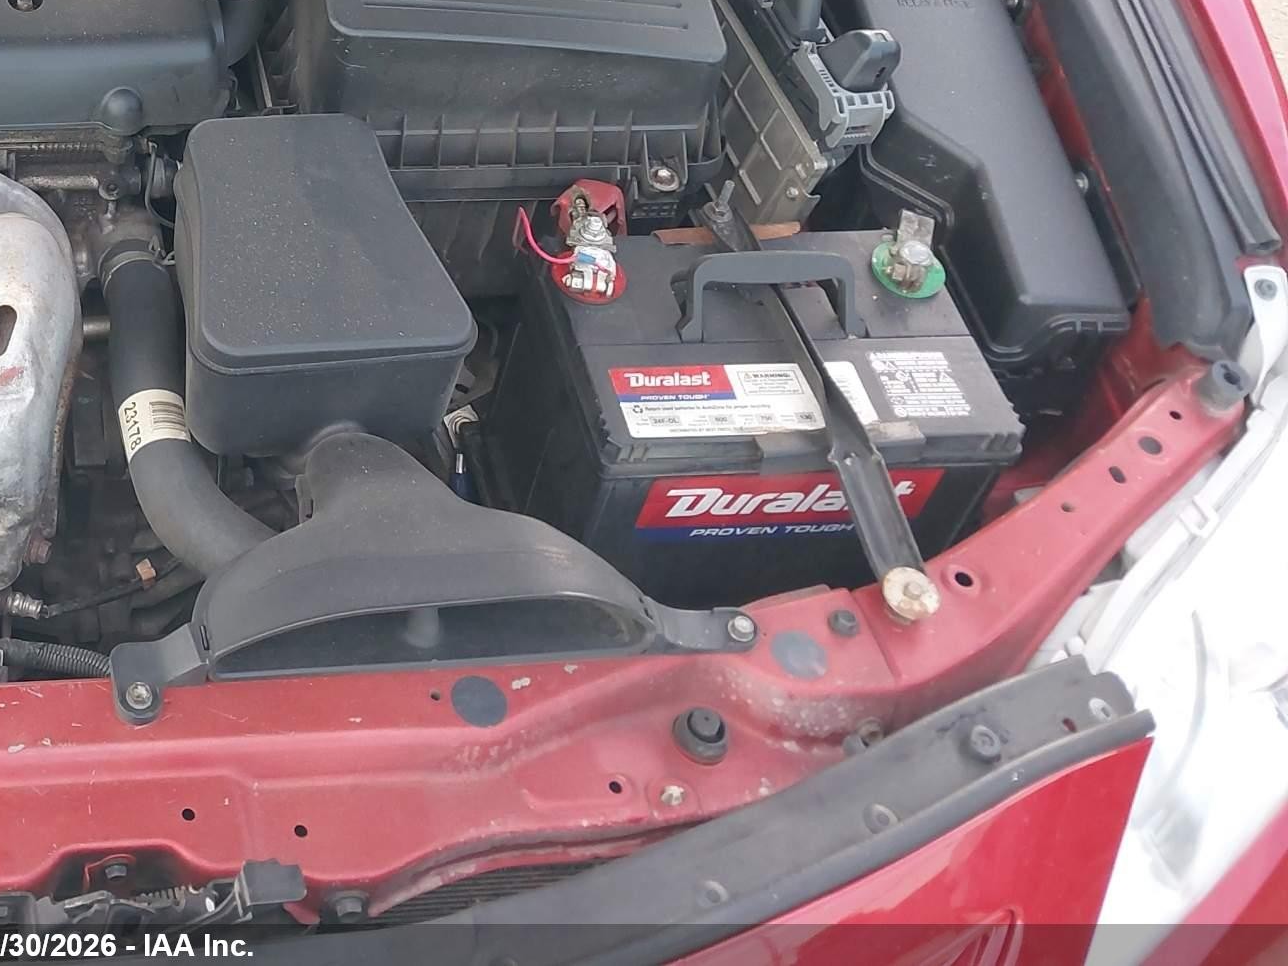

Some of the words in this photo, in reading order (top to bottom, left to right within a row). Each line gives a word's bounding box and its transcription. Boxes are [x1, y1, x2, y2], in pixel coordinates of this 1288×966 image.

[623, 371, 711, 387] Duralast
[123, 401, 142, 451] 23178
[665, 480, 916, 519] Duralat
[689, 525, 779, 537] PROVEN
[783, 523, 856, 535] TOUGH
